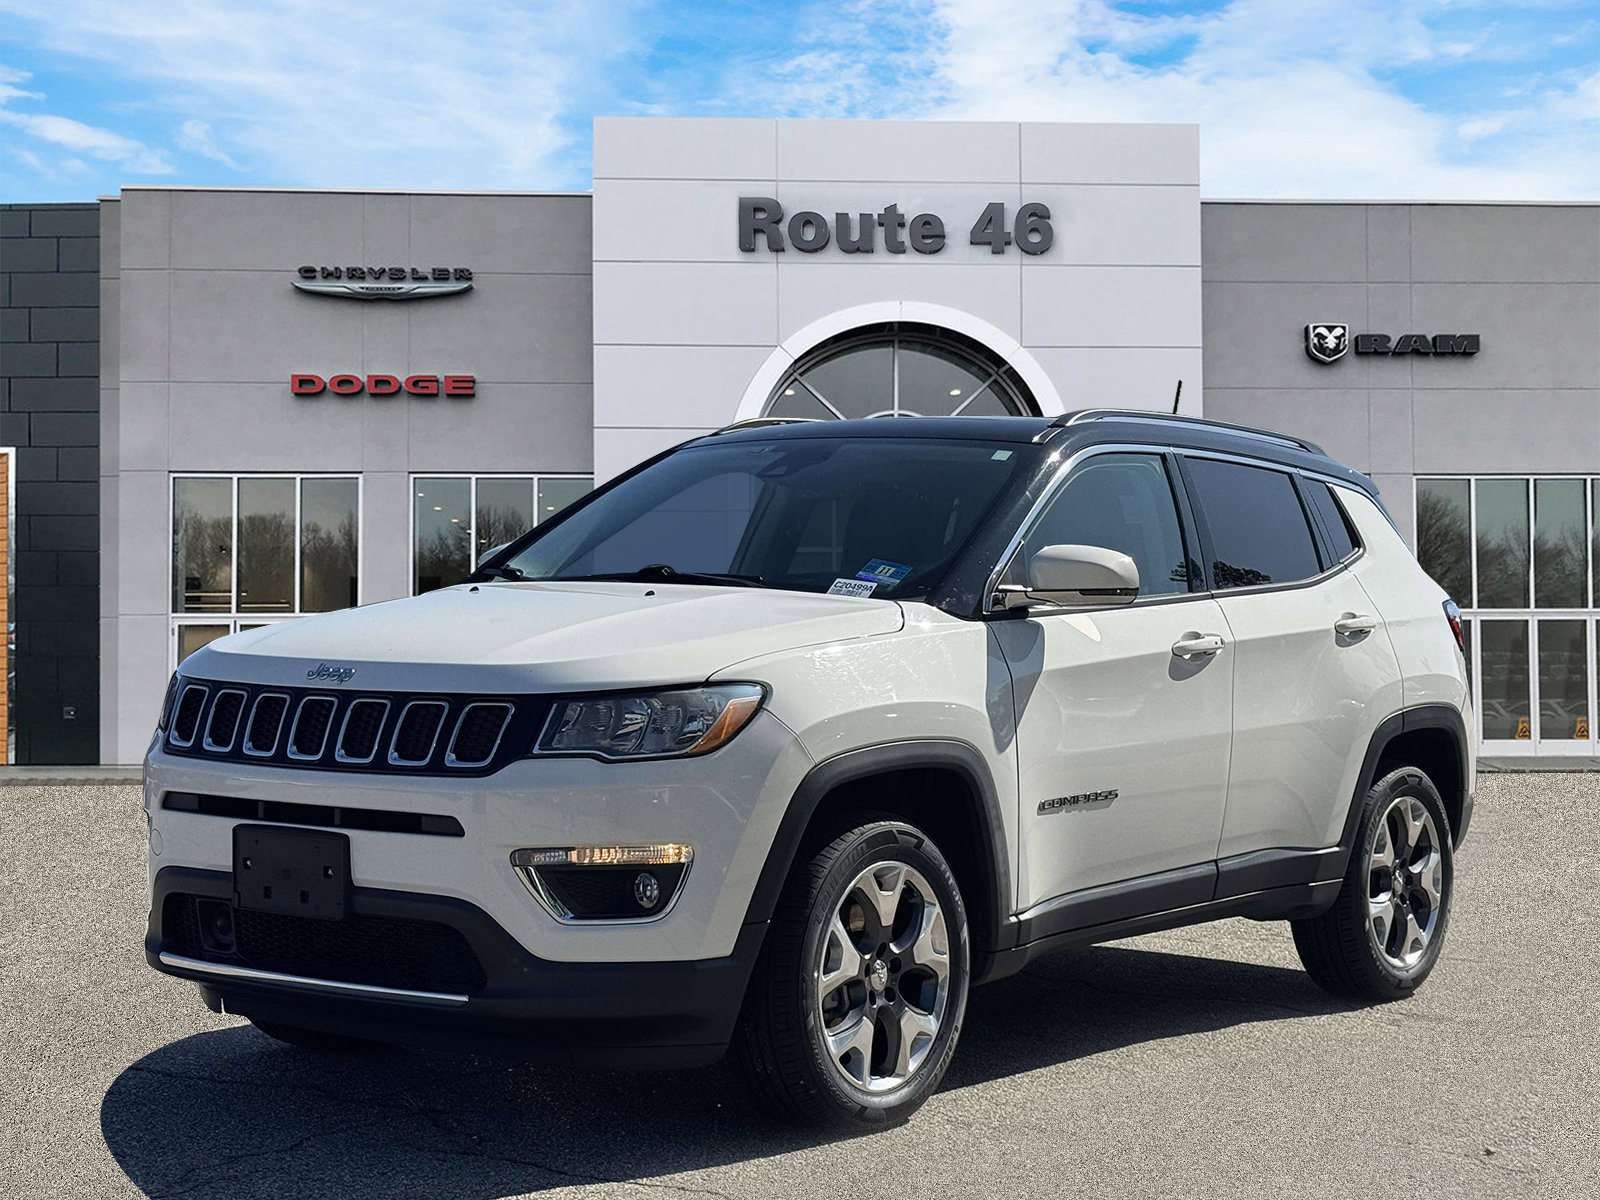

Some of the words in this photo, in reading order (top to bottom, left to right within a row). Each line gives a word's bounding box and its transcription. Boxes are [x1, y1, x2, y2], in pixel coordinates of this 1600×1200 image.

[738, 196, 946, 254] Route
[969, 201, 1054, 256] 46
[298, 266, 473, 281] CHRYSLER
[1354, 333, 1481, 355] RAM
[291, 374, 476, 397] DODGE
[833, 580, 873, 593] C20499A
[306, 661, 357, 686] Jeep
[1038, 788, 1119, 812] COMPASS
